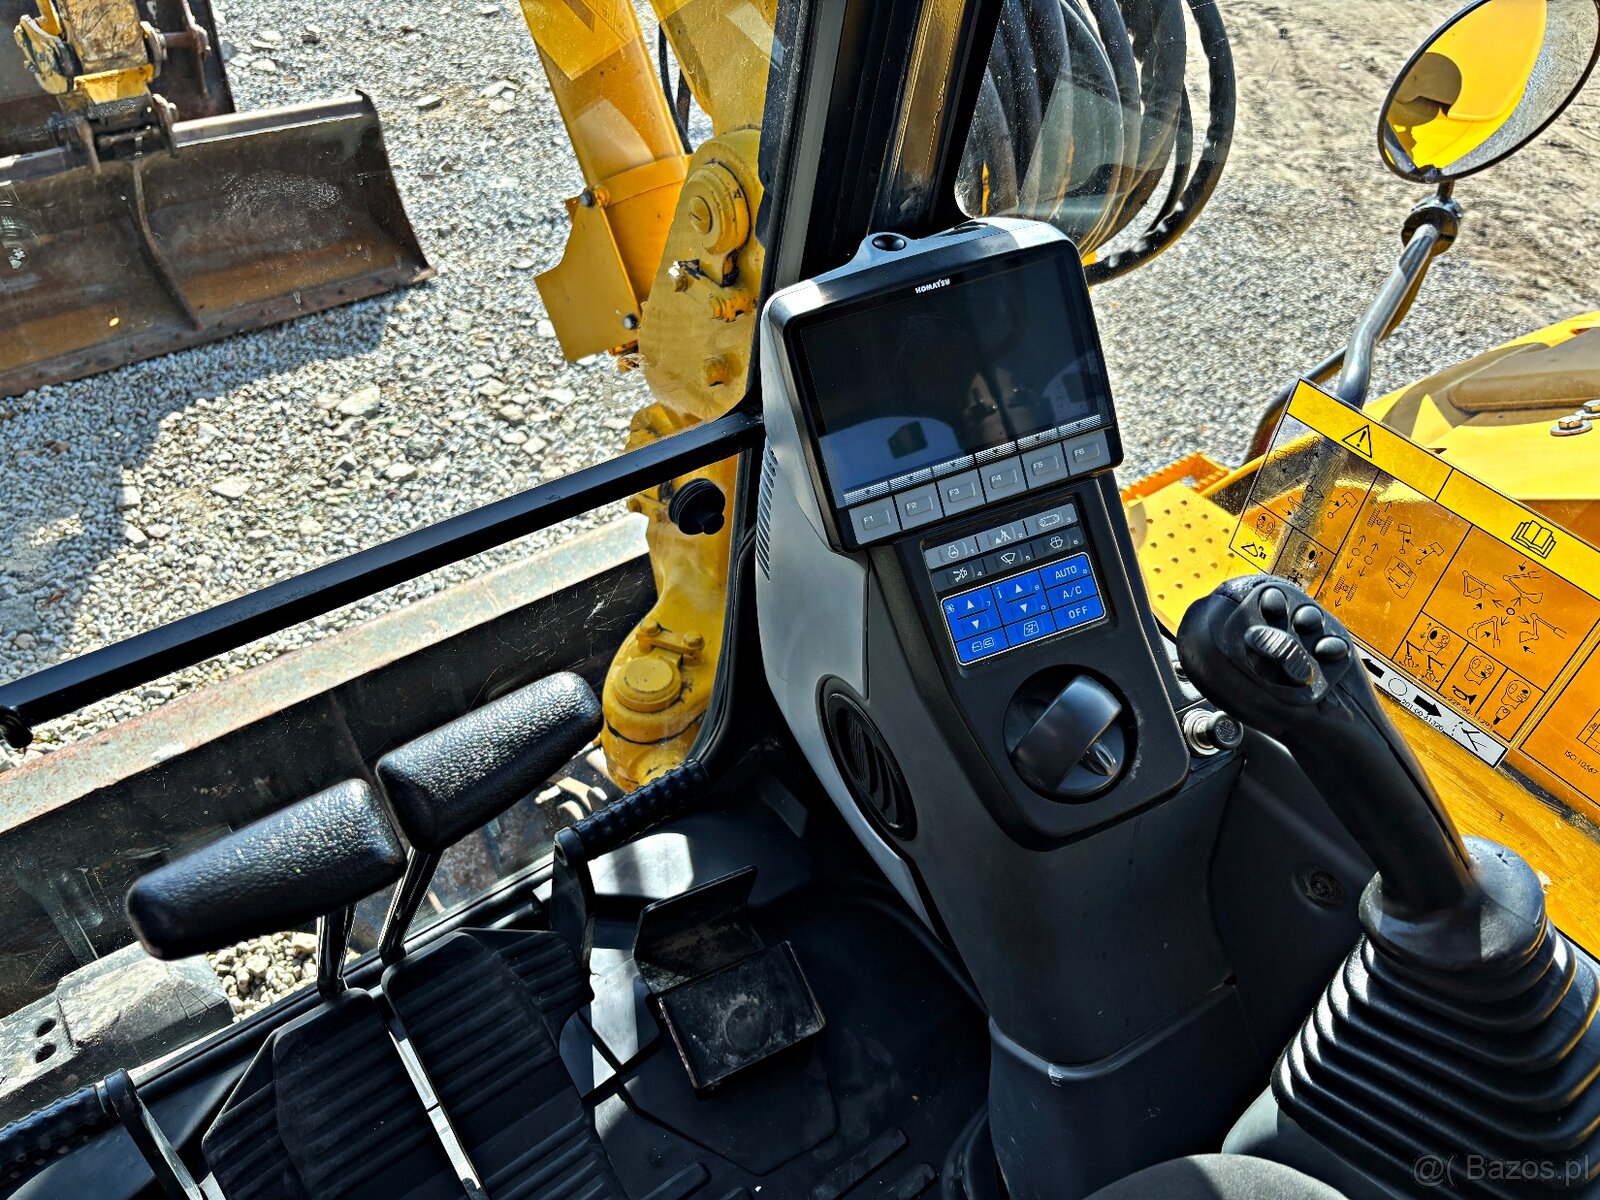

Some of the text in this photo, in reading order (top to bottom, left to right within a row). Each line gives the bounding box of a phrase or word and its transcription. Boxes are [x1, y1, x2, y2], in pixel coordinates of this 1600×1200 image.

[914, 278, 951, 294] KOMATSU
[863, 515, 874, 524] F1
[906, 501, 917, 510] F2
[949, 488, 960, 497] F3
[991, 474, 1002, 483] F4
[1033, 461, 1044, 470] F5
[1055, 565, 1077, 580] AUTO
[1063, 586, 1082, 599] A/C
[1069, 606, 1088, 619] OFF
[1564, 750, 1577, 761] ISO
